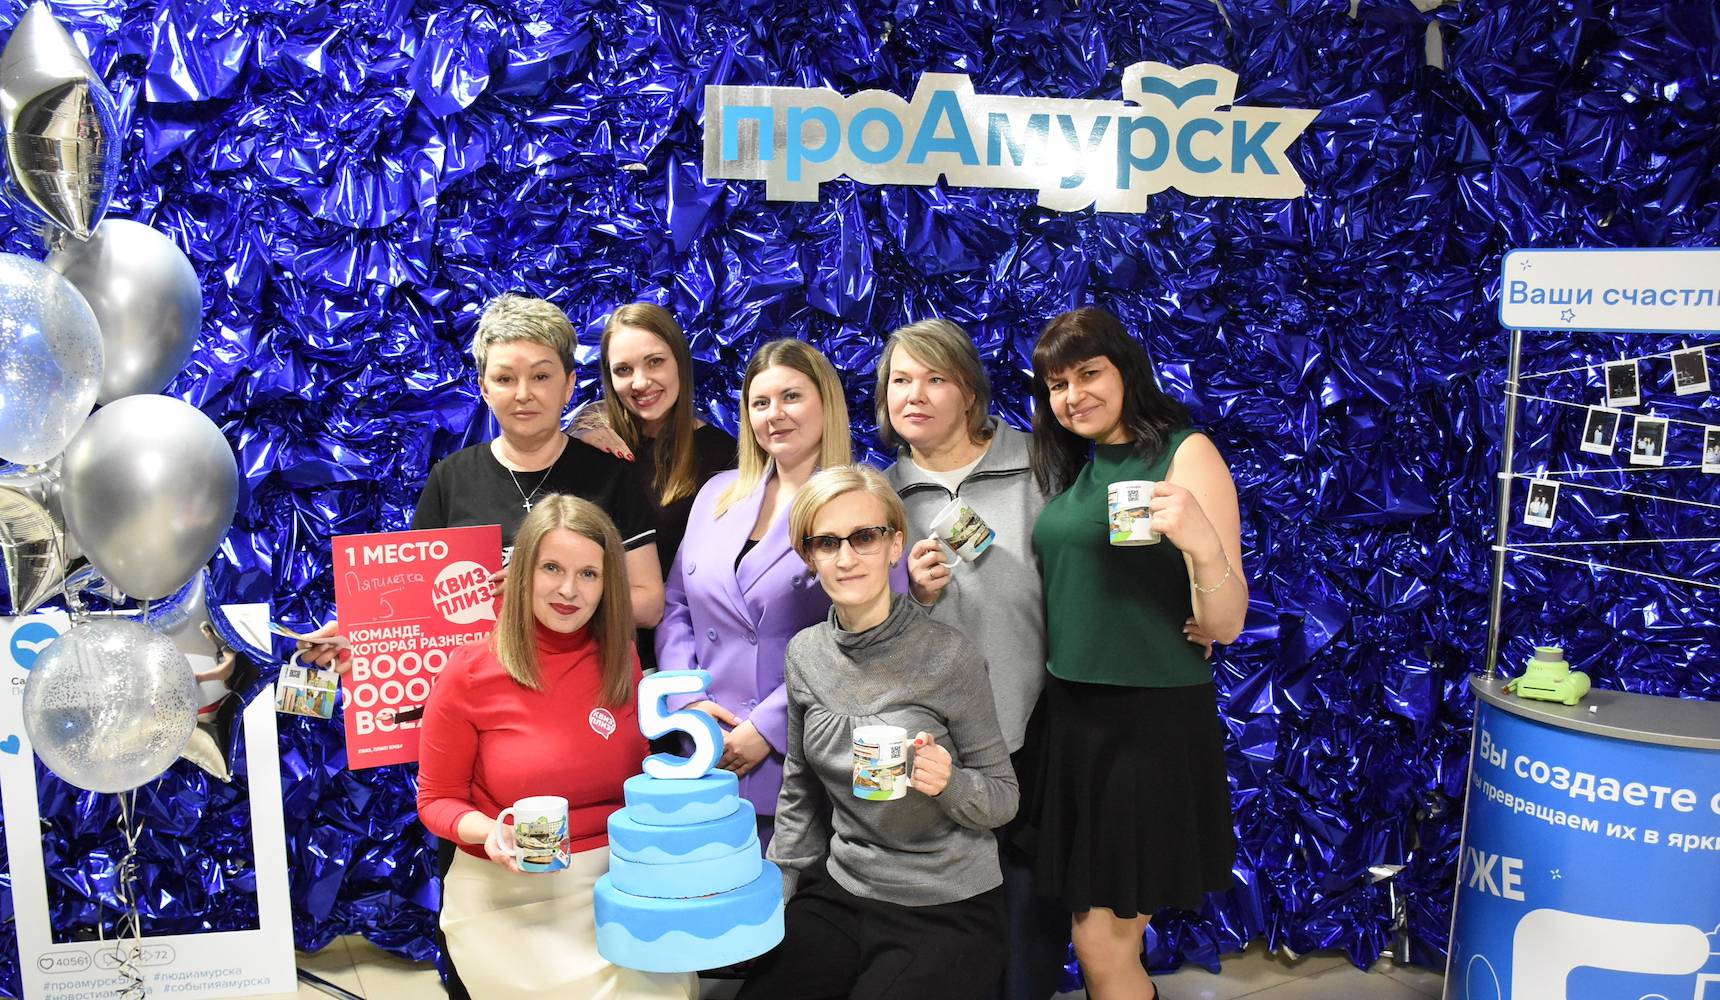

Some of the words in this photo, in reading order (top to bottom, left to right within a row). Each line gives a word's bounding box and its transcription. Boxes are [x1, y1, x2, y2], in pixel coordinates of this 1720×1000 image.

[722, 90, 1281, 191] проАмурск
[1509, 280, 1593, 306] Ваши
[345, 547, 356, 567] 1
[363, 540, 449, 566] МЕСТО
[349, 625, 425, 643] КОМАНДЕ,
[350, 639, 417, 656] КОТОРАЯ
[637, 669, 725, 779] 5
[1480, 729, 1507, 770] Вы
[1514, 755, 1697, 813] создаете
[1482, 780, 1599, 833] превращаем
[1606, 822, 1637, 841] их
[1643, 829, 1660, 844] в
[56, 957, 89, 967] 40561
[155, 950, 168, 960] 72
[153, 967, 243, 982] #людиамурска
